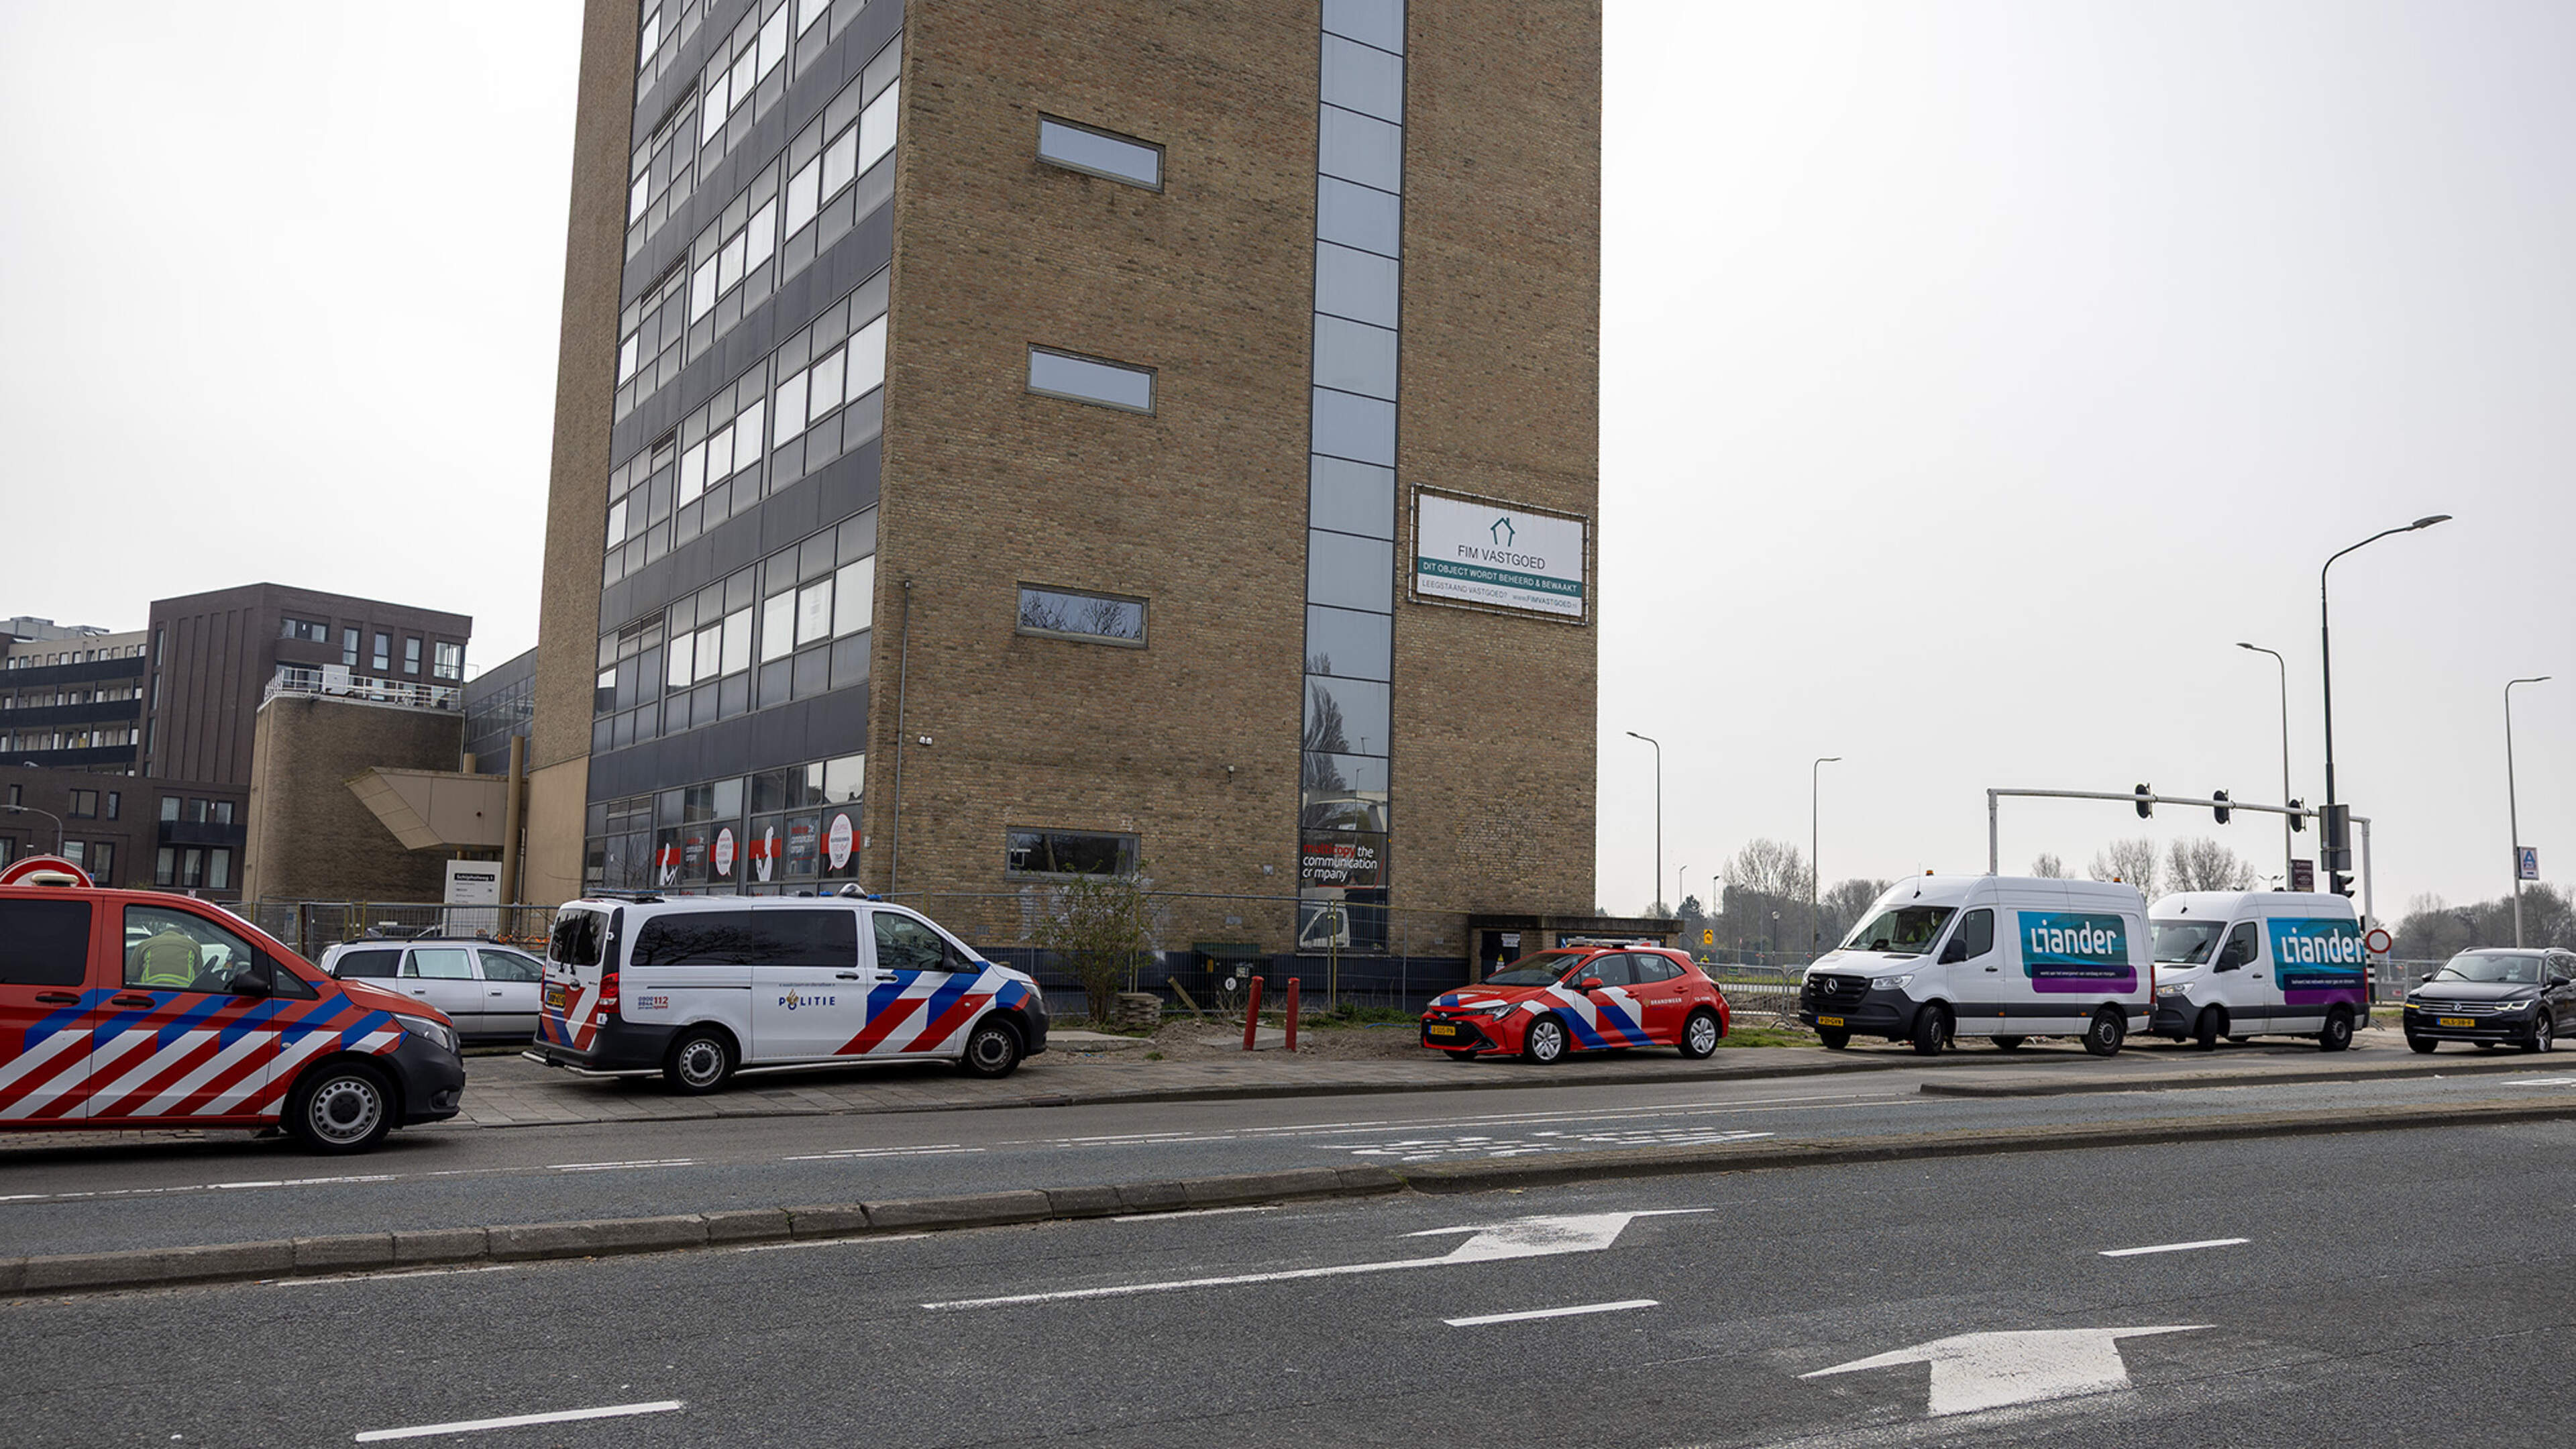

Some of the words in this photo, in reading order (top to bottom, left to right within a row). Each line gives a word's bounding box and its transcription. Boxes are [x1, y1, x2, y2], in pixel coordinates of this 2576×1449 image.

[1458, 545, 1479, 559] FIM
[1481, 548, 1546, 570] VASTGOED
[1423, 561, 1438, 571] DIT
[1437, 564, 1468, 576] OBJECT
[1469, 568, 1498, 581] WORDT
[1499, 573, 1534, 587] BEHEERD
[1535, 579, 1540, 588] &
[1541, 580, 1578, 593] BEWAAKT
[1468, 586, 1508, 599] VASTGOED?
[1303, 842, 1356, 858] multicopy
[1357, 845, 1375, 858] the
[1302, 855, 1379, 870] communication
[2031, 919, 2117, 955] Liander
[2281, 926, 2365, 963] Liander
[654, 996, 669, 1004] 112
[779, 996, 836, 1010] POLITIE
[1650, 998, 1682, 1006] BRANDWEER
